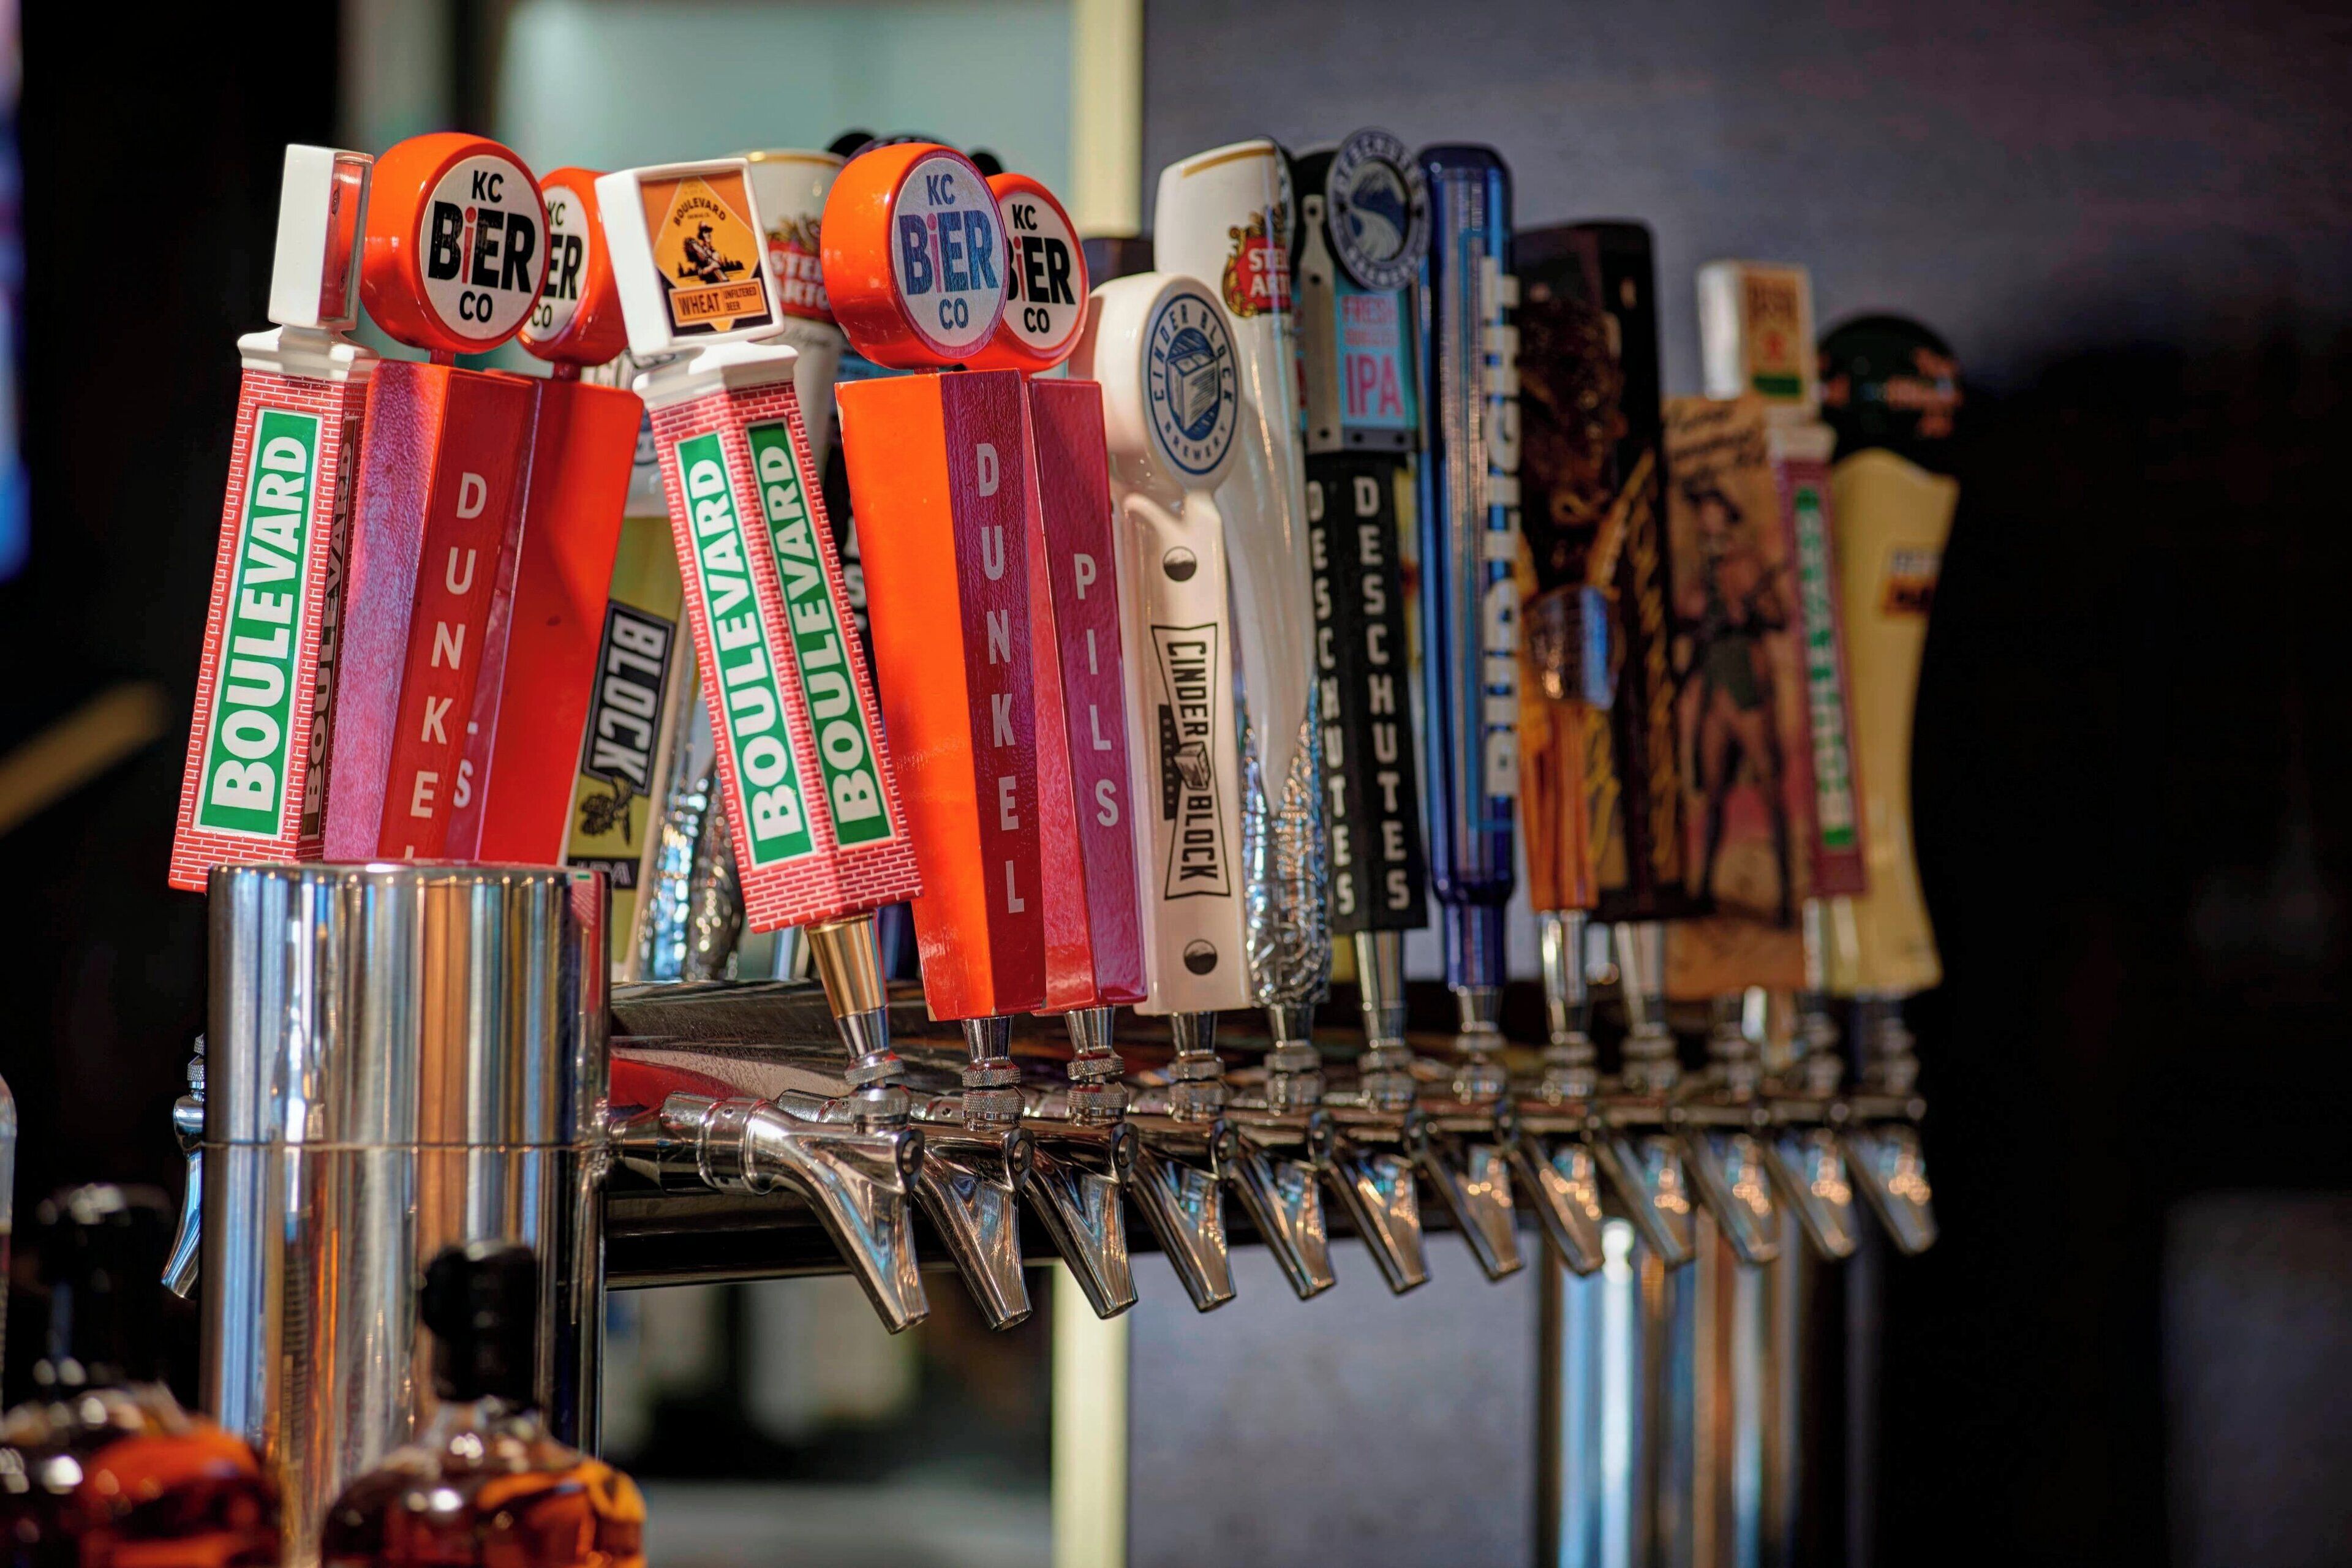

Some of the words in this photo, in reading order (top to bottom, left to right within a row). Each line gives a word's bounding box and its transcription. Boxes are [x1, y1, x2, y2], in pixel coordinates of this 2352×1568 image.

[472, 170, 503, 203] KC
[674, 197, 726, 226] BOULEVARD
[926, 173, 956, 206] KC
[1012, 203, 1038, 230] KC
[428, 200, 536, 294] BiER
[543, 233, 583, 300] ER
[899, 209, 999, 296] BiER
[1250, 273, 1291, 298] ART
[459, 291, 493, 323] CO
[532, 303, 552, 328] CO
[678, 293, 720, 315] WHEAT
[724, 286, 756, 300] UNFILTERED
[726, 301, 741, 311] BEER
[938, 298, 970, 330] CO
[1023, 307, 1050, 333] CO
[1153, 304, 1188, 401] CINDER
[1200, 309, 1233, 402] BLOCK
[1346, 353, 1404, 417] IPA
[1481, 257, 1520, 559] LIGHT
[211, 435, 306, 812] BOULEVARD
[306, 441, 351, 815] BOULEVARD
[404, 472, 486, 859] DUNKE
[689, 459, 803, 841] BOULEVARD
[759, 447, 881, 824] BOULEVARD
[592, 614, 669, 784] BLOCK
[976, 442, 1025, 914] DUNKEL
[1074, 553, 1118, 827] PILS
[1167, 640, 1208, 737] CINDER
[1308, 481, 1354, 914] DESCHUTES
[1354, 477, 1409, 910] DESCHUTES
[1482, 579, 1520, 797] BUD
[1180, 795, 1218, 881] BLOCK
